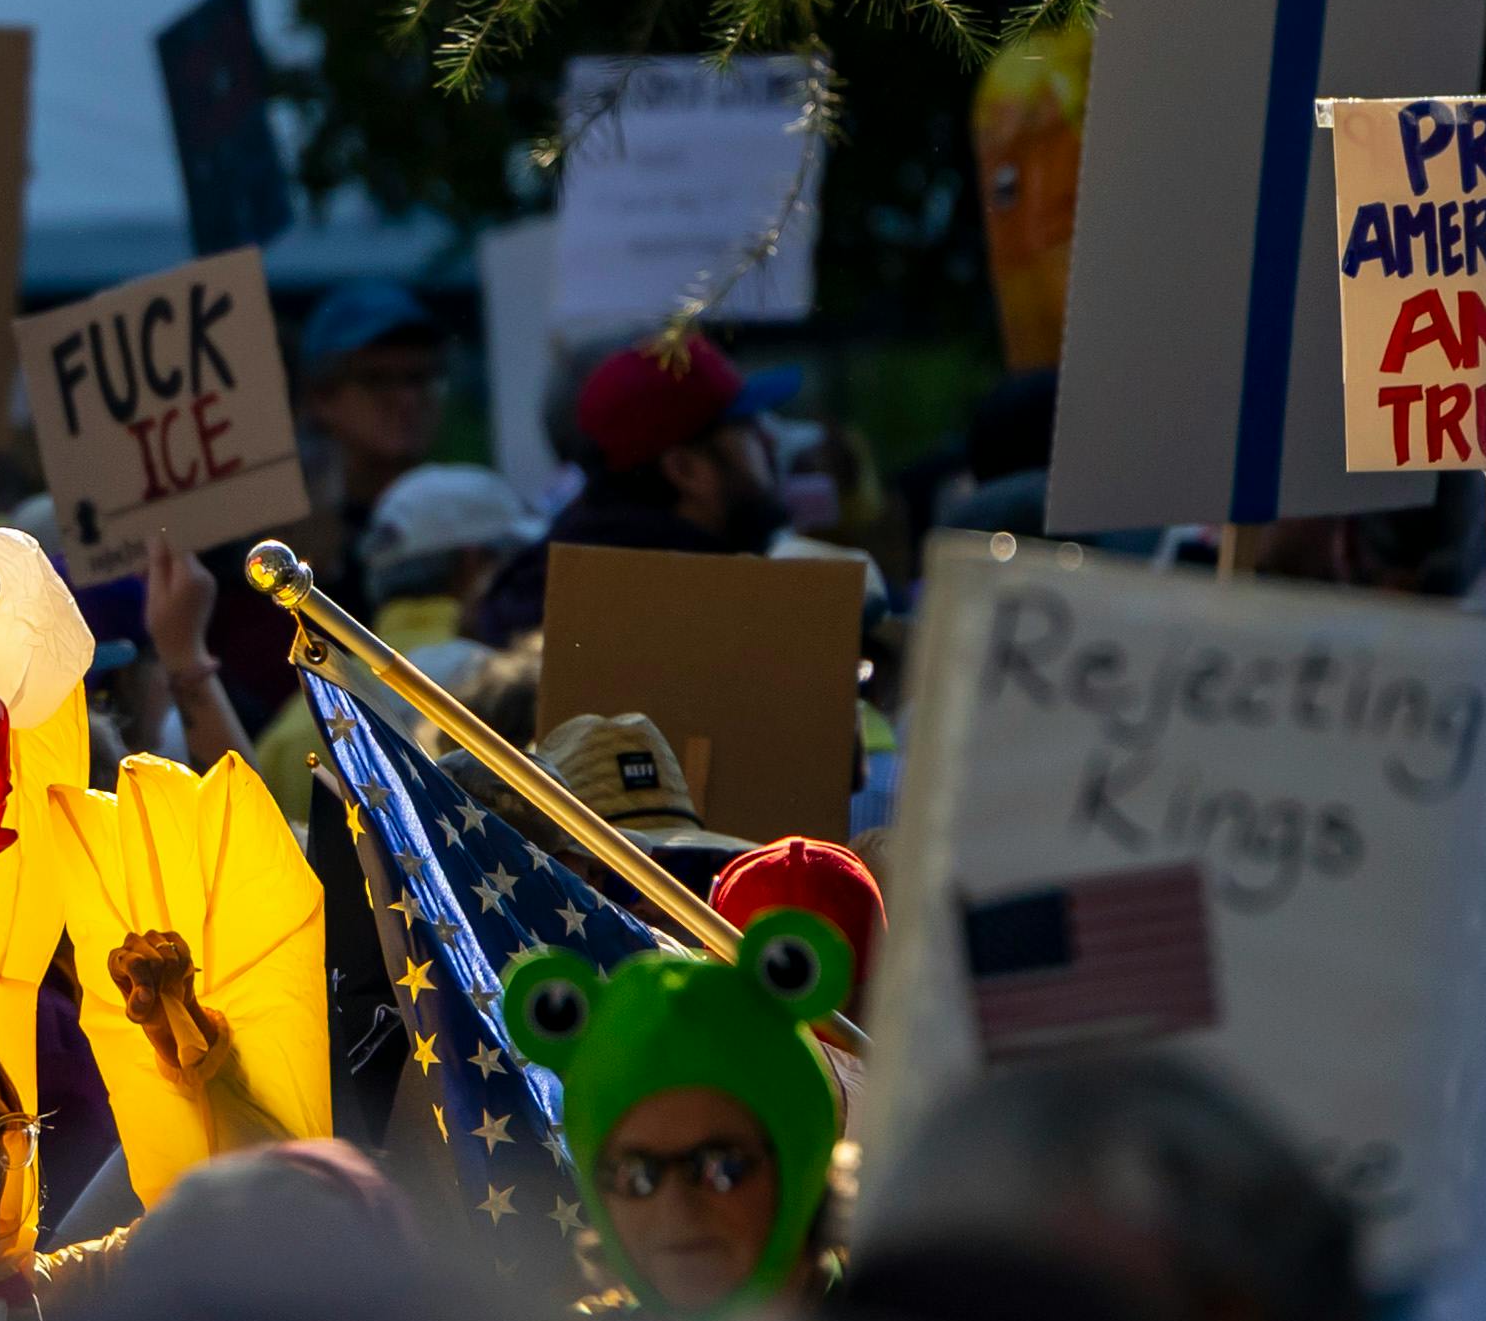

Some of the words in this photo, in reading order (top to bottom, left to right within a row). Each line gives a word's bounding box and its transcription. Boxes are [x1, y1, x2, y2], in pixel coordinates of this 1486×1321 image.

[51, 284, 236, 438] FUCK
[127, 392, 243, 502] ICE
[982, 583, 1486, 806] Rejecting
[1071, 746, 1366, 918] Kings
